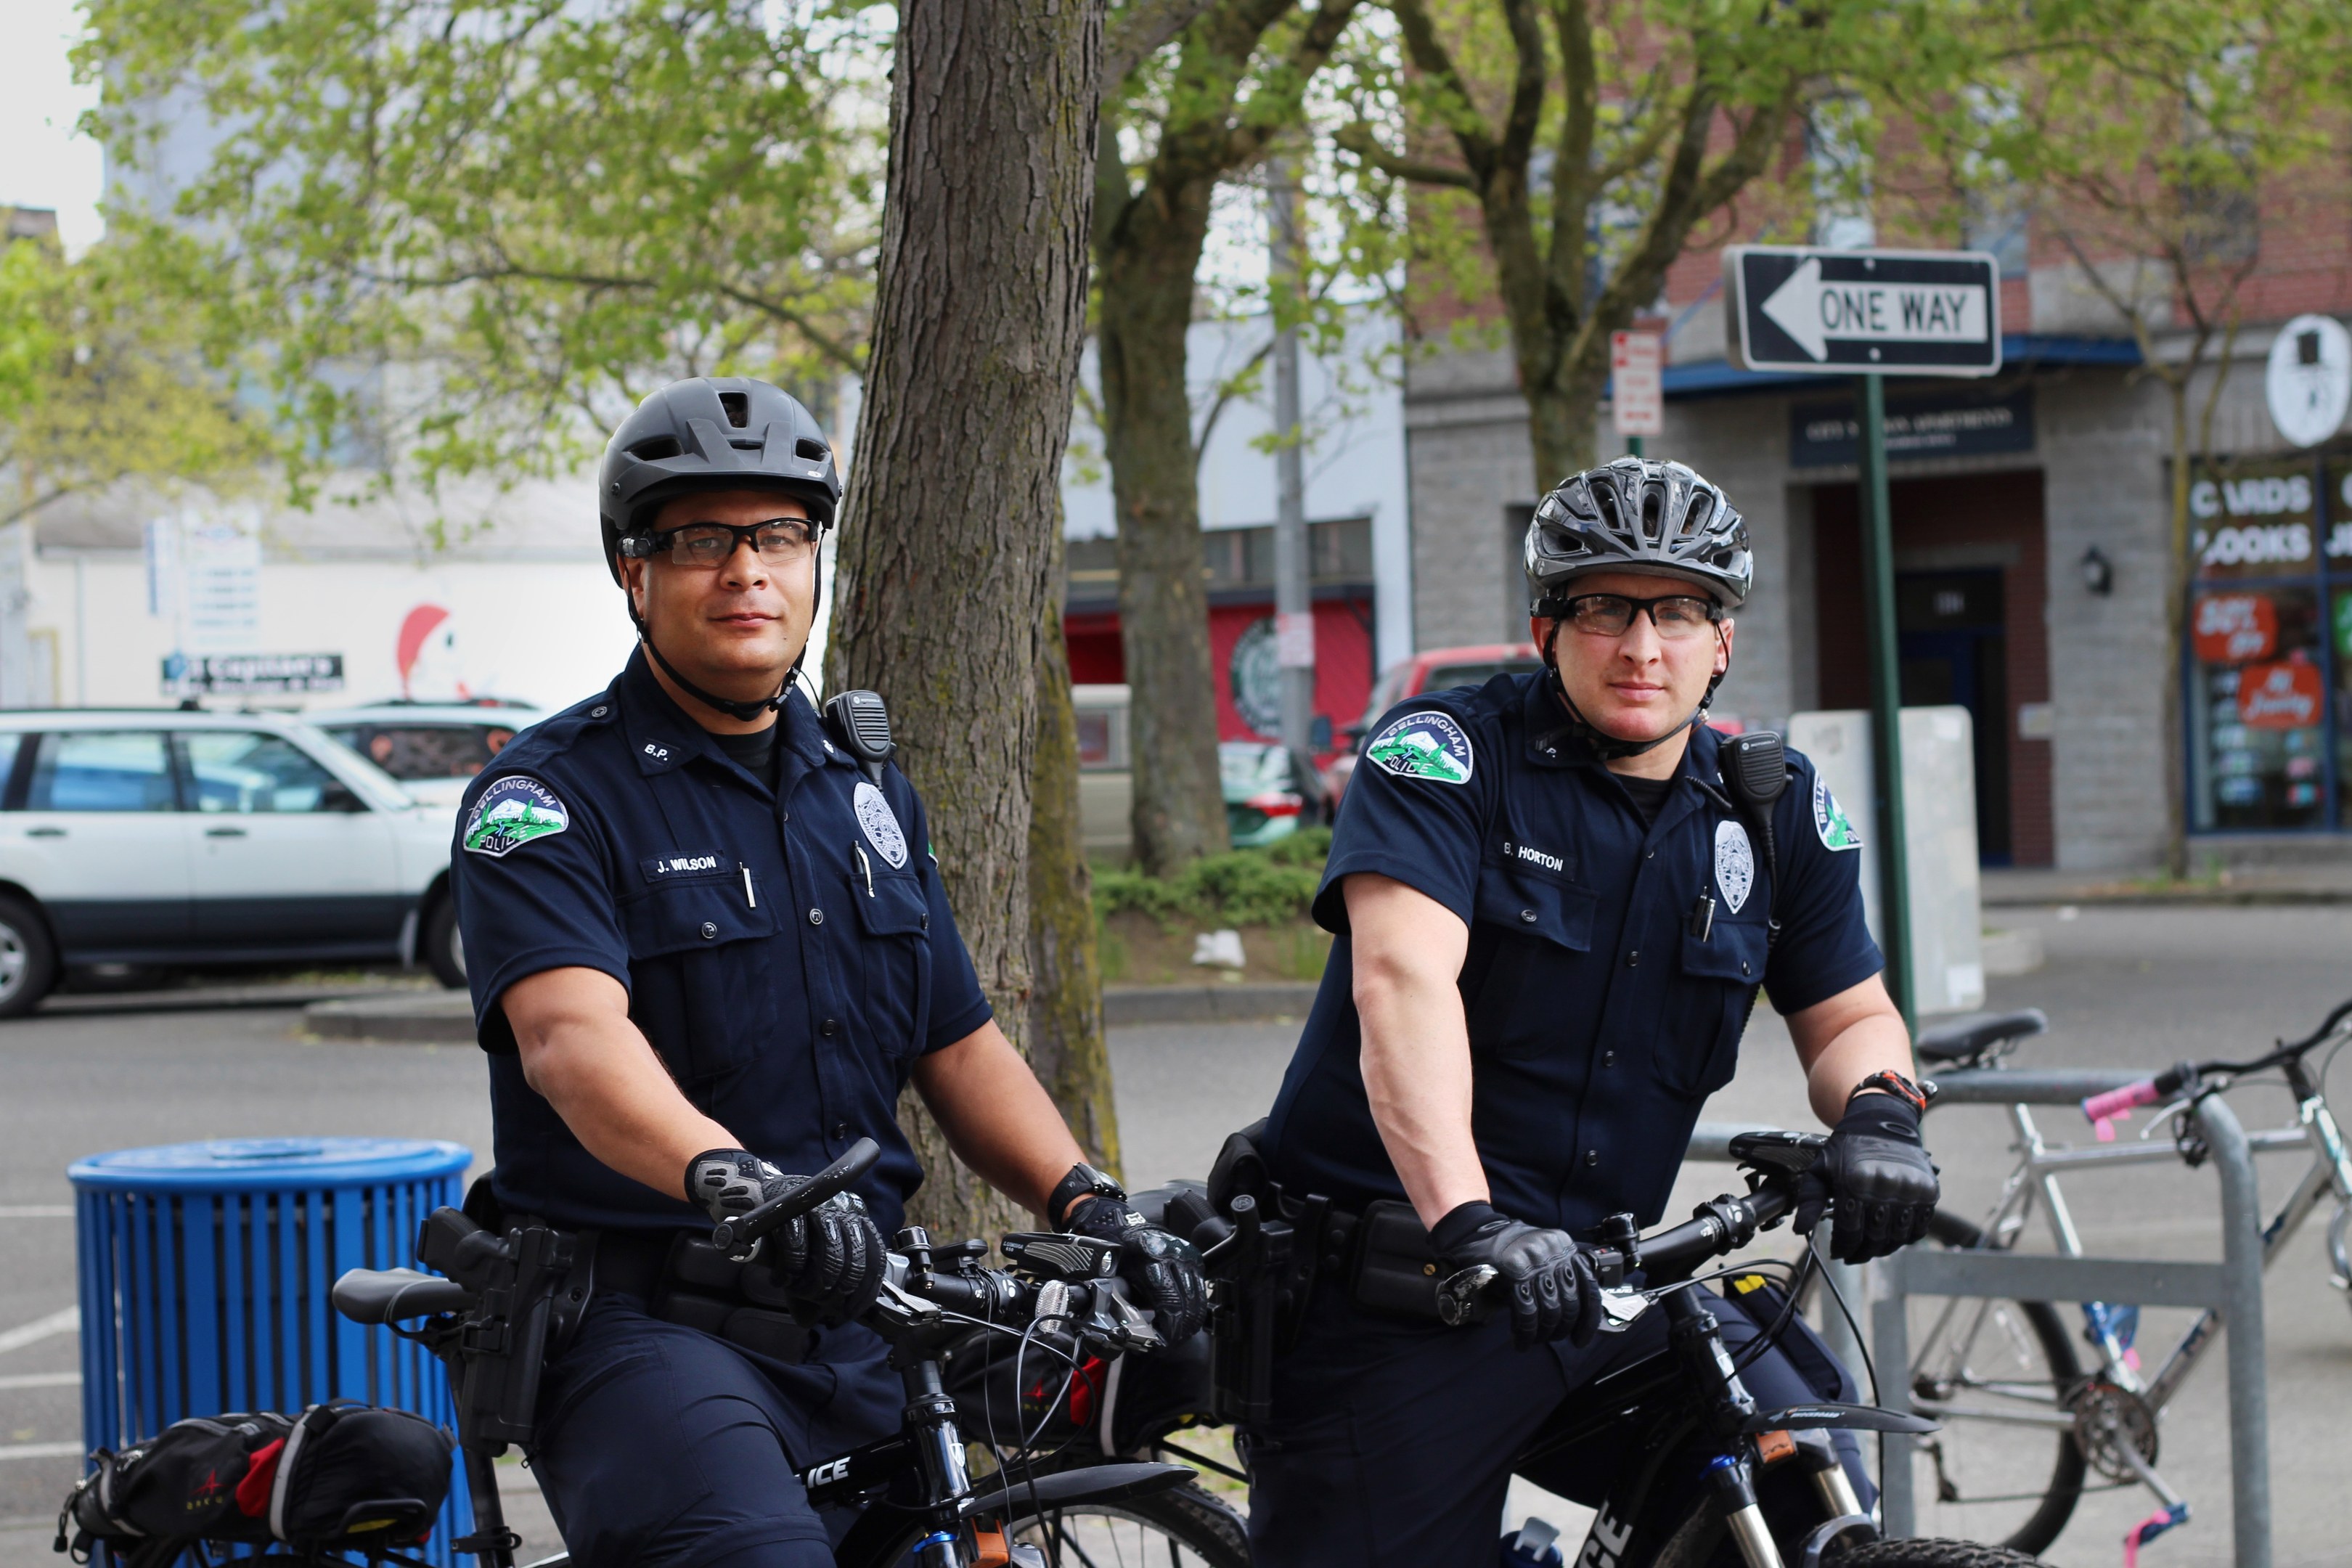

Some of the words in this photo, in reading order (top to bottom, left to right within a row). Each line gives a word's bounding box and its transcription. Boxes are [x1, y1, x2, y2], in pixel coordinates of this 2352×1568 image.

[1821, 288, 1887, 331] ONE
[1899, 291, 1969, 333] WAY
[1387, 716, 1467, 757] BELLINGHAM
[644, 743, 669, 761] B.P.
[1383, 752, 1434, 773] POLICE
[473, 780, 556, 820] BELLINGHAM
[478, 825, 530, 851] POLICE
[657, 860, 669, 873] J.
[669, 856, 717, 871] WILSON
[1504, 842, 1513, 856] B.
[1518, 846, 1564, 872] HORTON
